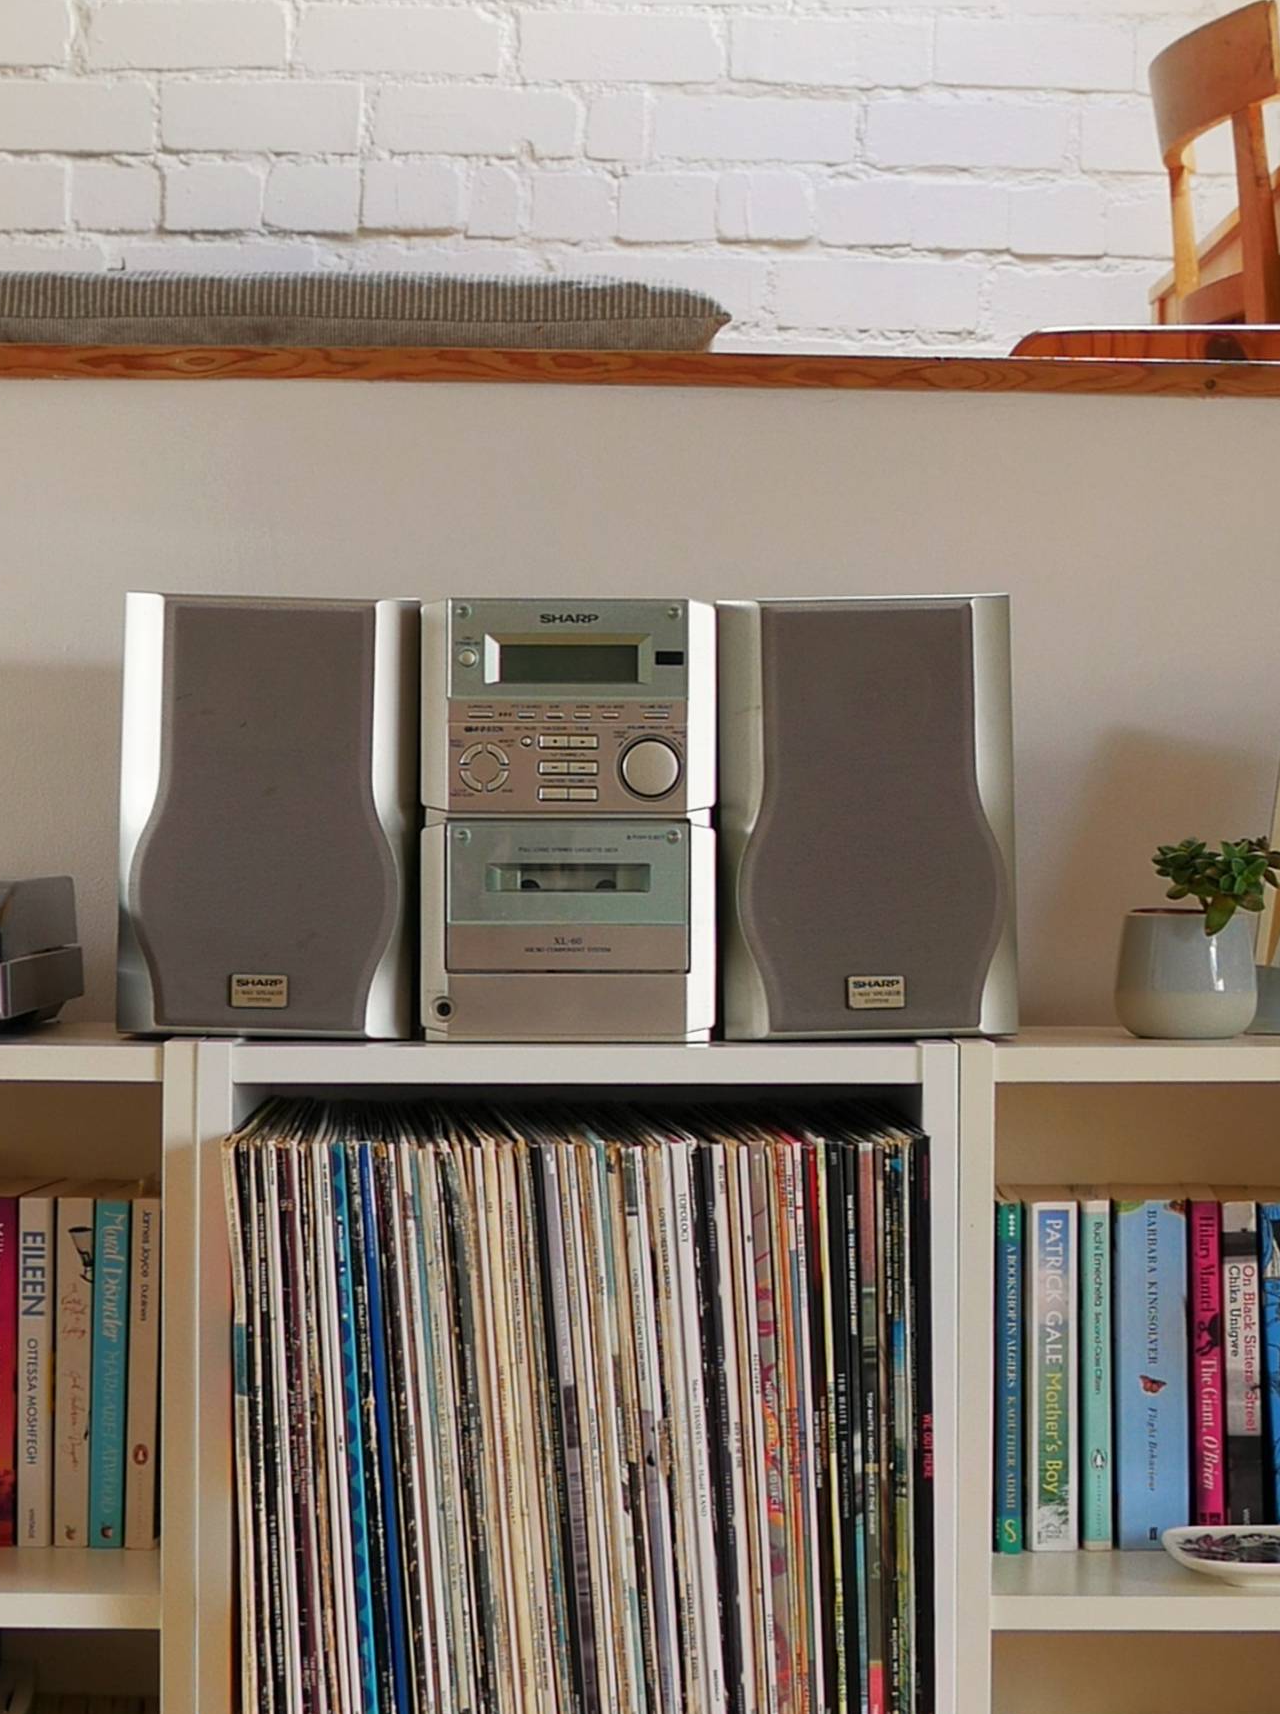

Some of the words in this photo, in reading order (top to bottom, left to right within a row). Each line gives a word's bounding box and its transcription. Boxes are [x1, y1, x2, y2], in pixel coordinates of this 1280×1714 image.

[539, 613, 599, 624] SHARP
[235, 978, 283, 987] SHARP
[677, 1193, 688, 1243] TOPOLOGY
[1194, 1215, 1214, 1260] Hilary
[1045, 1219, 1061, 1302] PATRICK
[1146, 1210, 1157, 1273] BARBARA
[21, 1231, 44, 1316] EILEEN
[1198, 1265, 1214, 1312] Mantel
[1228, 1265, 1240, 1304] Chika
[1242, 1265, 1254, 1287] On
[1146, 1281, 1157, 1365] KINGSOLVER
[1227, 1308, 1240, 1357] Unigwe
[1243, 1292, 1254, 1330] Black
[1045, 1311, 1061, 1364] GALE
[26, 1339, 37, 1391] OTTESSA
[1201, 1358, 1215, 1385] The
[25, 1396, 36, 1464] MOSHFEGH
[837, 1397, 845, 1424] WAITS
[922, 1414, 932, 1429] WE
[1045, 1372, 1061, 1451] Mother's
[1244, 1392, 1256, 1432] Street
[923, 1432, 932, 1450] OUT
[1202, 1436, 1217, 1489] O'Brien
[923, 1453, 932, 1478] HERE
[1042, 1460, 1061, 1493] Boy
